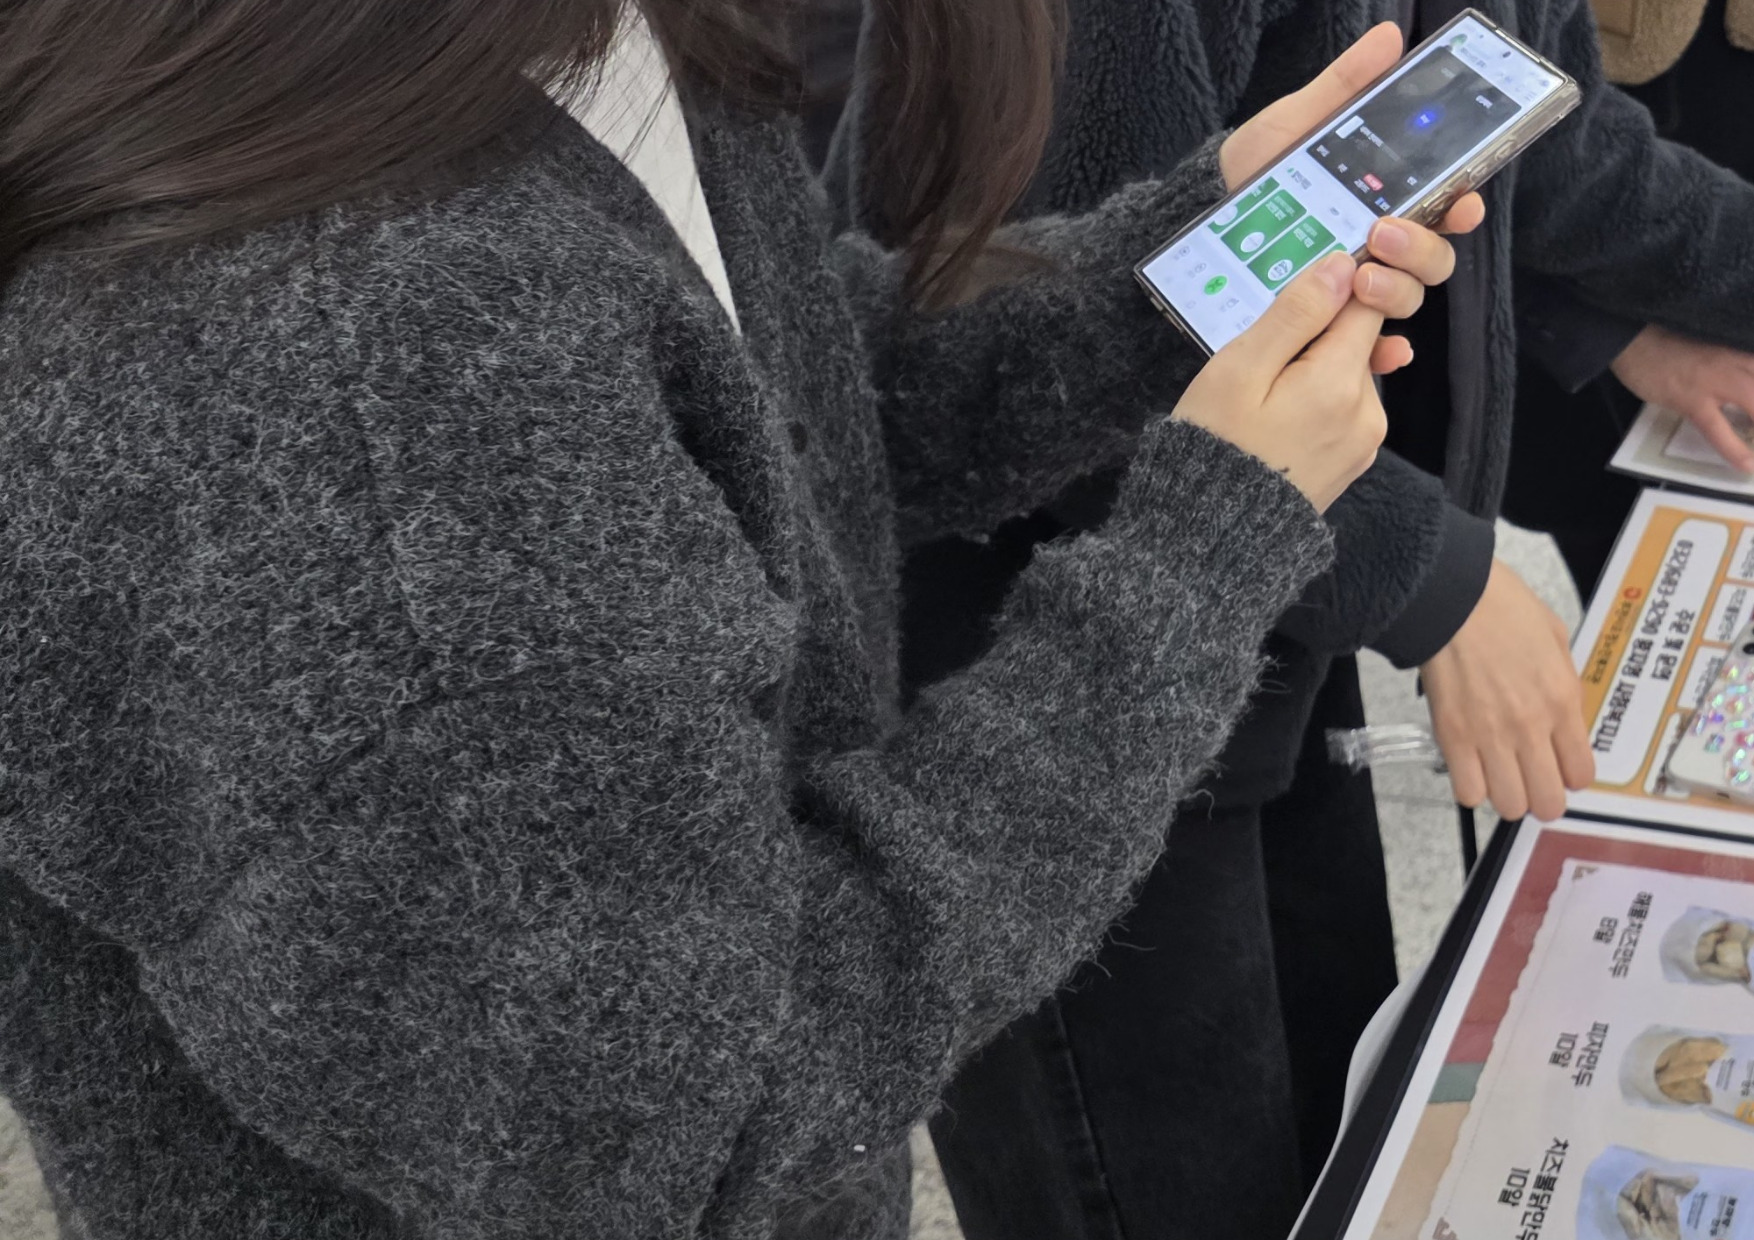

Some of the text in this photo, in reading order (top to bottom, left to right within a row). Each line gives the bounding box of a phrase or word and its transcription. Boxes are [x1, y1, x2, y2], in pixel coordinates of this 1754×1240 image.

[1668, 609, 1695, 635] 주문
[1651, 654, 1679, 682] 문의
[1593, 917, 1619, 945] 8알
[1608, 891, 1654, 979] 해물치즈만두
[1547, 1033, 1578, 1069] 10알
[1571, 1021, 1610, 1088] 피자만두
[1498, 1167, 1531, 1207] 10알
